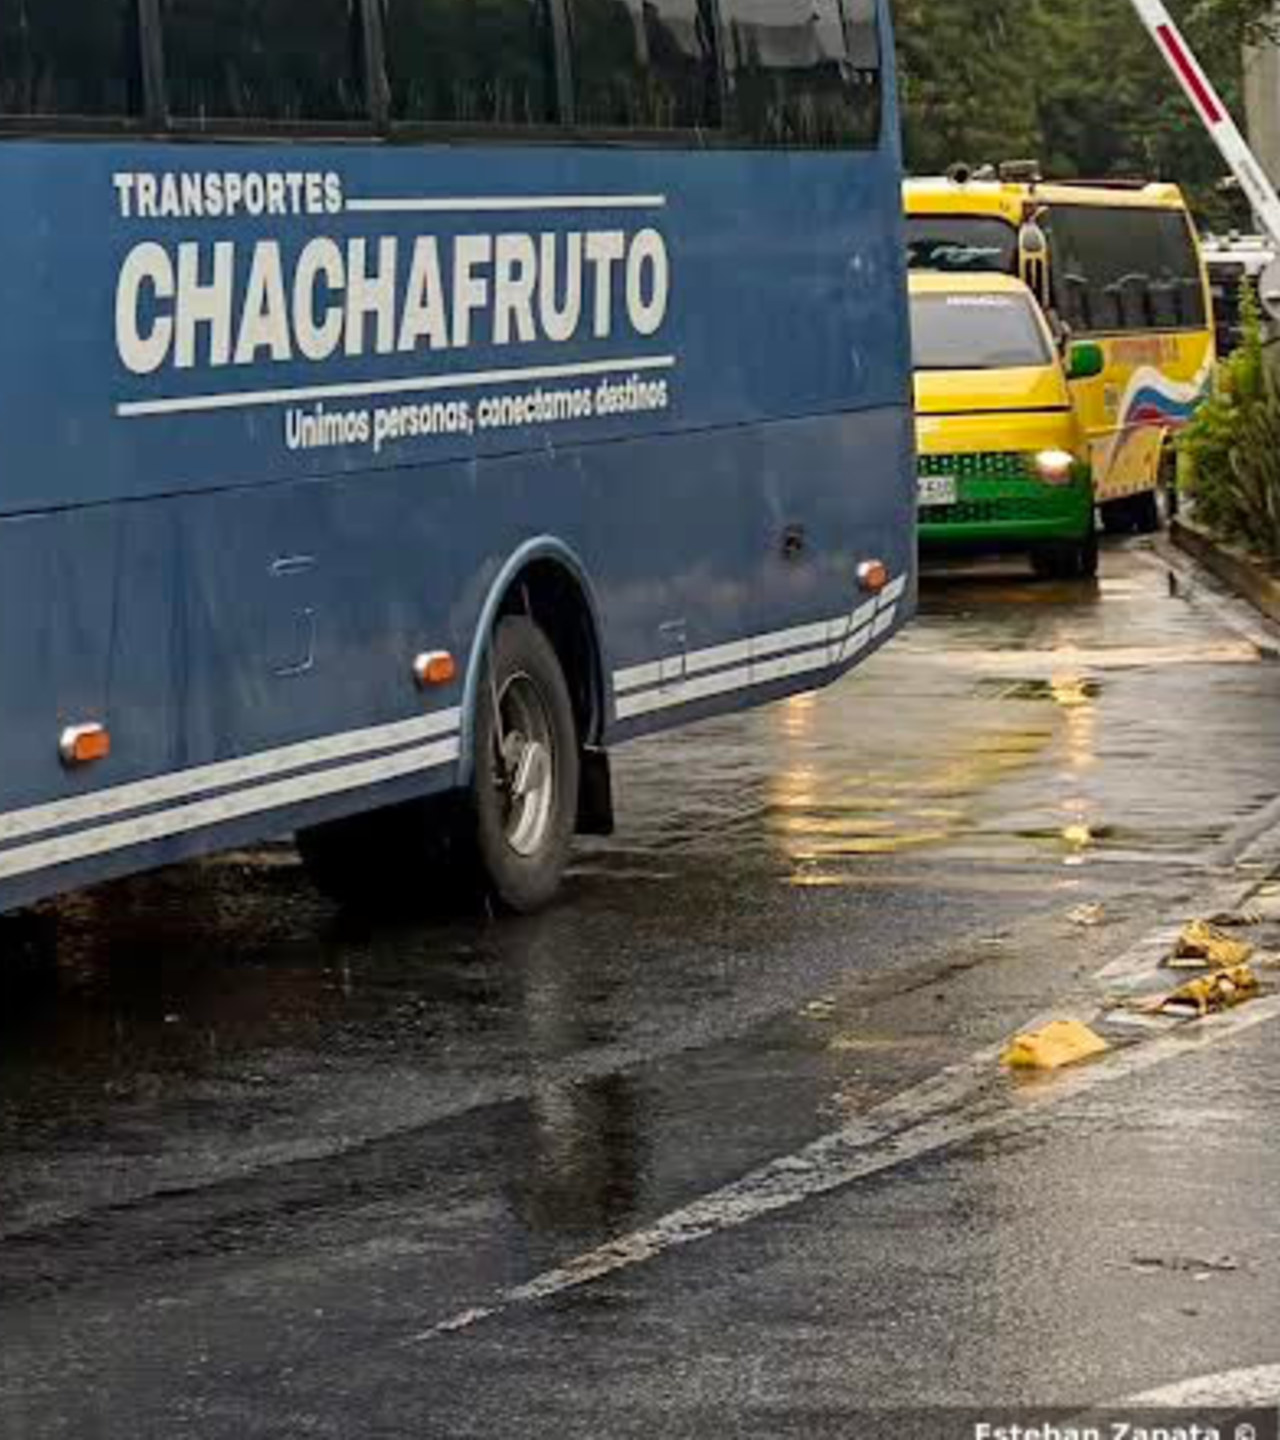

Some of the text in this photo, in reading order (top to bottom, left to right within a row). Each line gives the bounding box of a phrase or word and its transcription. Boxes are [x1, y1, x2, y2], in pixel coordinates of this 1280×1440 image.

[113, 173, 343, 217] TRANSPORTES
[115, 228, 669, 373] CHACHAFRUTO
[285, 374, 668, 451] Unimos personas, conectamos destinos
